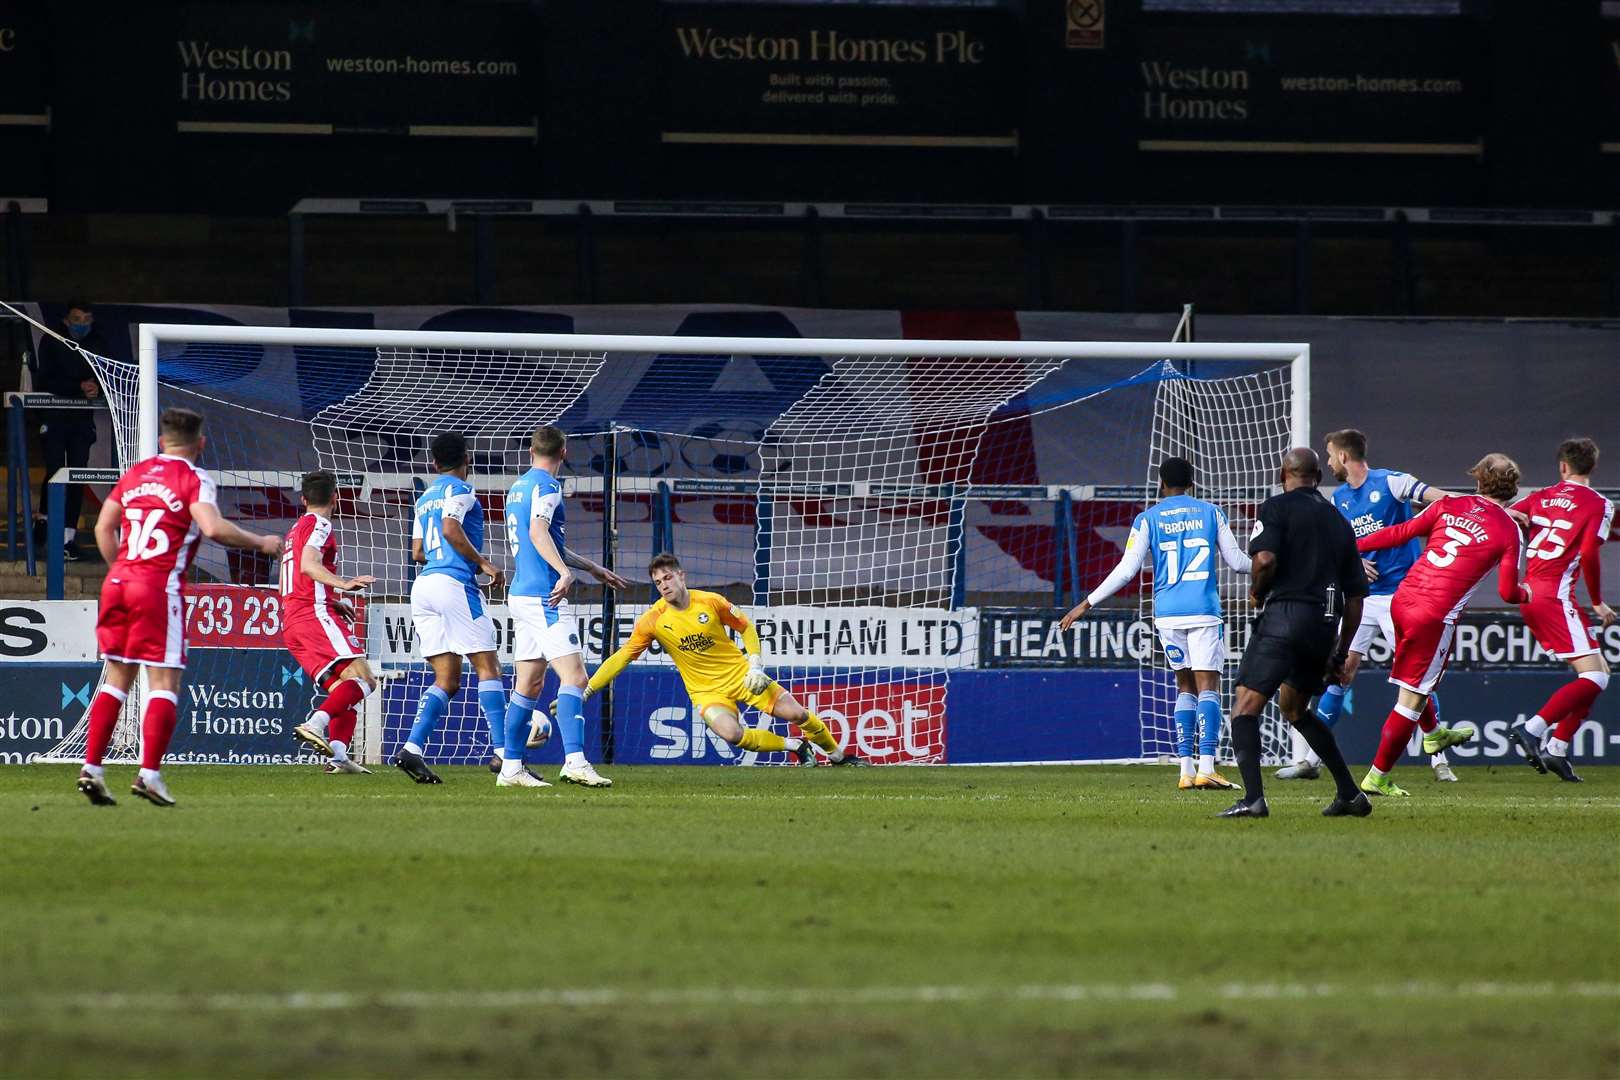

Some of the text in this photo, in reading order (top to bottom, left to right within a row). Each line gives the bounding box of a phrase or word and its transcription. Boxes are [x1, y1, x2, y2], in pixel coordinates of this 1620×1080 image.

[177, 40, 293, 71] Weston
[675, 26, 985, 64] Weston Homes Plc
[325, 55, 518, 76] weston-homes.com
[769, 73, 801, 87] Built
[805, 73, 833, 87] with
[1138, 60, 1250, 90] Weston
[180, 72, 292, 101] Homes
[1280, 74, 1463, 93] weston-homes.com
[761, 90, 899, 108] delivered with pride.
[1142, 91, 1248, 120] Homes
[125, 508, 170, 561] 16
[1164, 519, 1203, 535] BROWN
[1350, 512, 1375, 529] MICK
[1353, 519, 1385, 538] EORGE
[1426, 526, 1473, 568] 3
[1526, 515, 1574, 561] 25
[1159, 537, 1210, 584] 12
[680, 632, 705, 647] MICK
[901, 618, 963, 656] LTD
[993, 619, 1154, 659] HEATING
[188, 684, 284, 710] Weston
[190, 710, 284, 735] Homes
